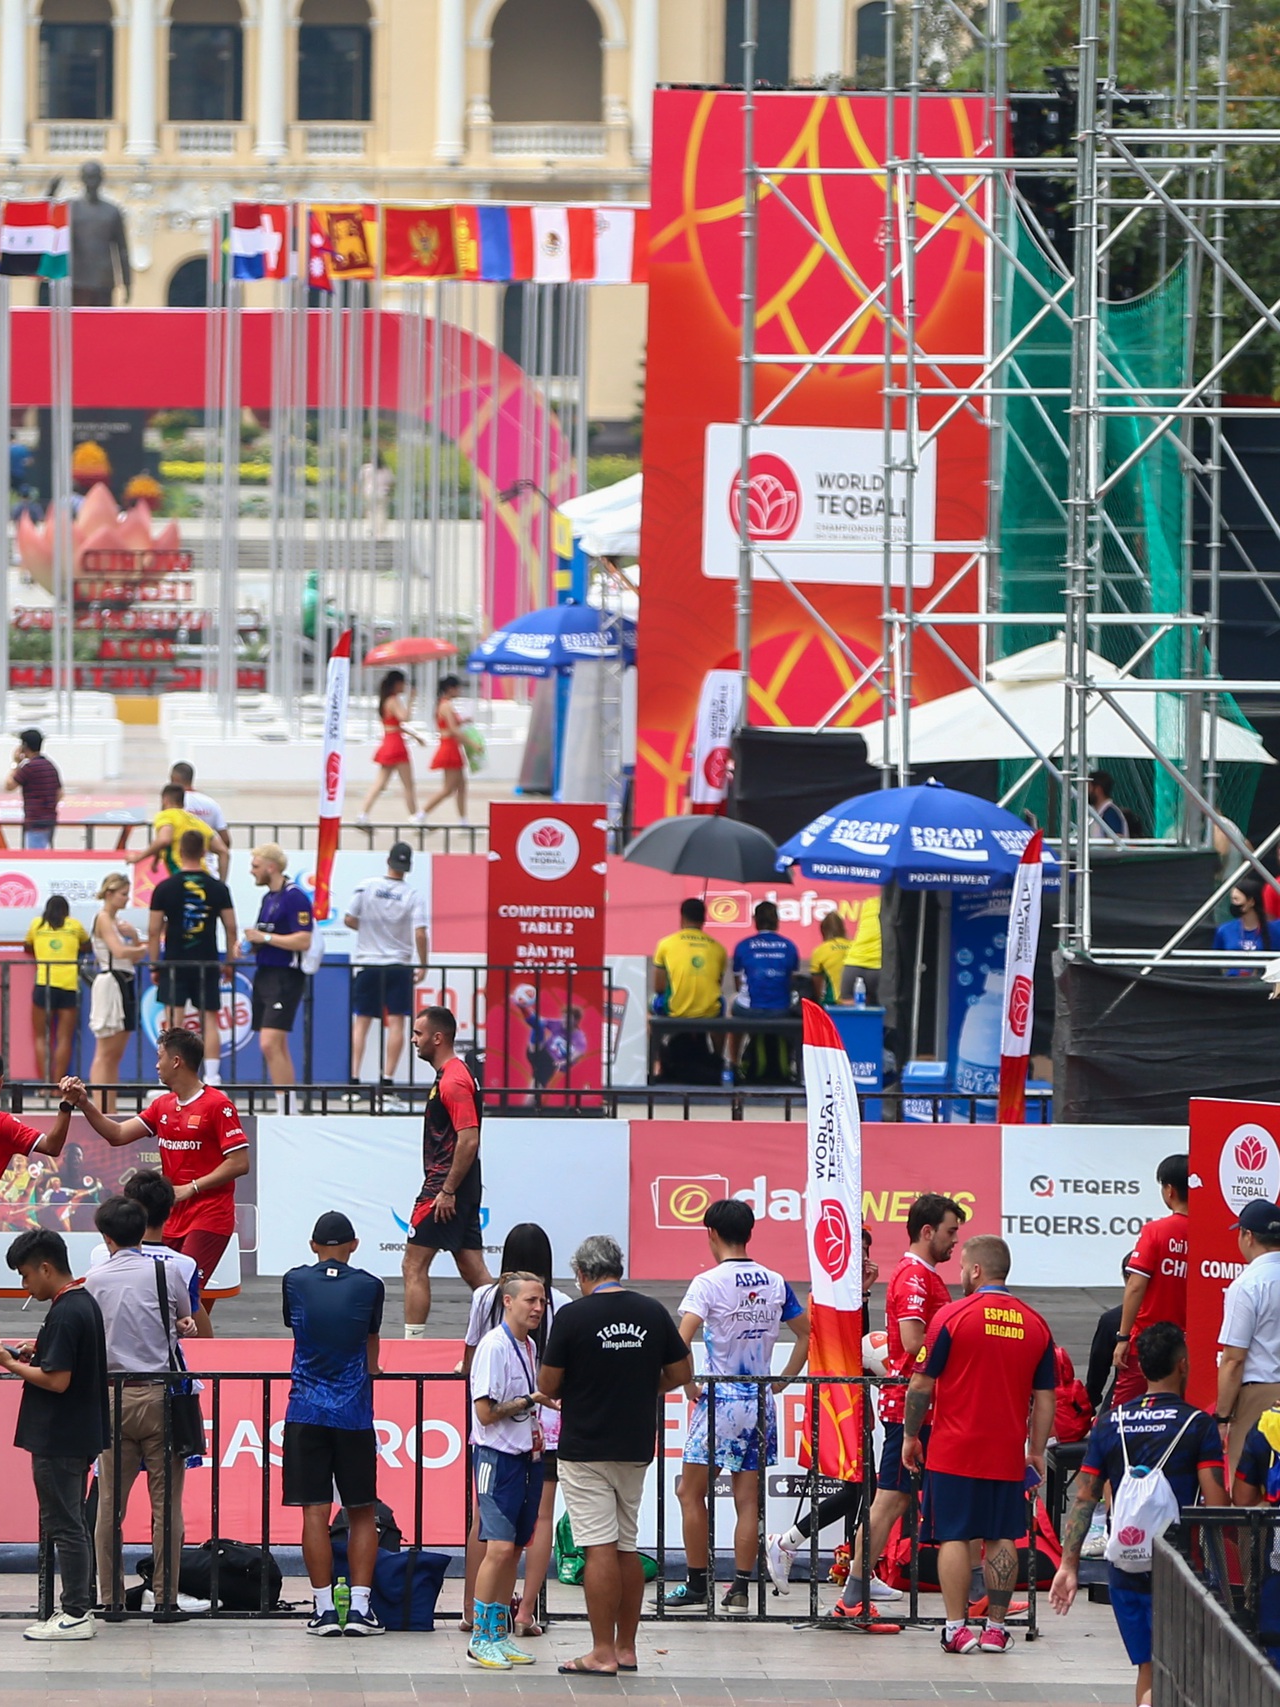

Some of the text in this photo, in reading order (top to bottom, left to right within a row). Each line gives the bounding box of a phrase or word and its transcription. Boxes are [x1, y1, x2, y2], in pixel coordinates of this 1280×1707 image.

[816, 472, 885, 491] WORLD
[817, 494, 908, 519] TEQBALL
[836, 819, 900, 836] POCARI
[910, 826, 983, 841] POCARI
[830, 829, 887, 843] SWEAT
[911, 836, 976, 849] SWEAT
[812, 863, 881, 878] POCARI SWEAT
[909, 873, 991, 885] POCARI SWEAT
[498, 904, 595, 918] COMPETITION
[519, 921, 574, 935] TABLE 2
[517, 941, 574, 958] BÀN THI
[957, 1077, 999, 1092] SWEA
[815, 1105, 828, 1180] WORLD
[1059, 1178, 1141, 1195] TEQERS
[1236, 1175, 1264, 1186] WORLD
[1231, 1185, 1269, 1198] TEQBALL
[1001, 1214, 1160, 1237] TEQERS.CO
[735, 1271, 770, 1288] ARAI
[739, 1298, 767, 1307] JAPAN
[983, 1307, 1025, 1325] ESPAÑA
[596, 1322, 648, 1341] TEQBALL
[984, 1323, 1025, 1340] DELGADO
[602, 1339, 643, 1350] #illegalattack
[1110, 1408, 1179, 1423] MUÑOZ
[1116, 1424, 1167, 1434] ECUADOR
